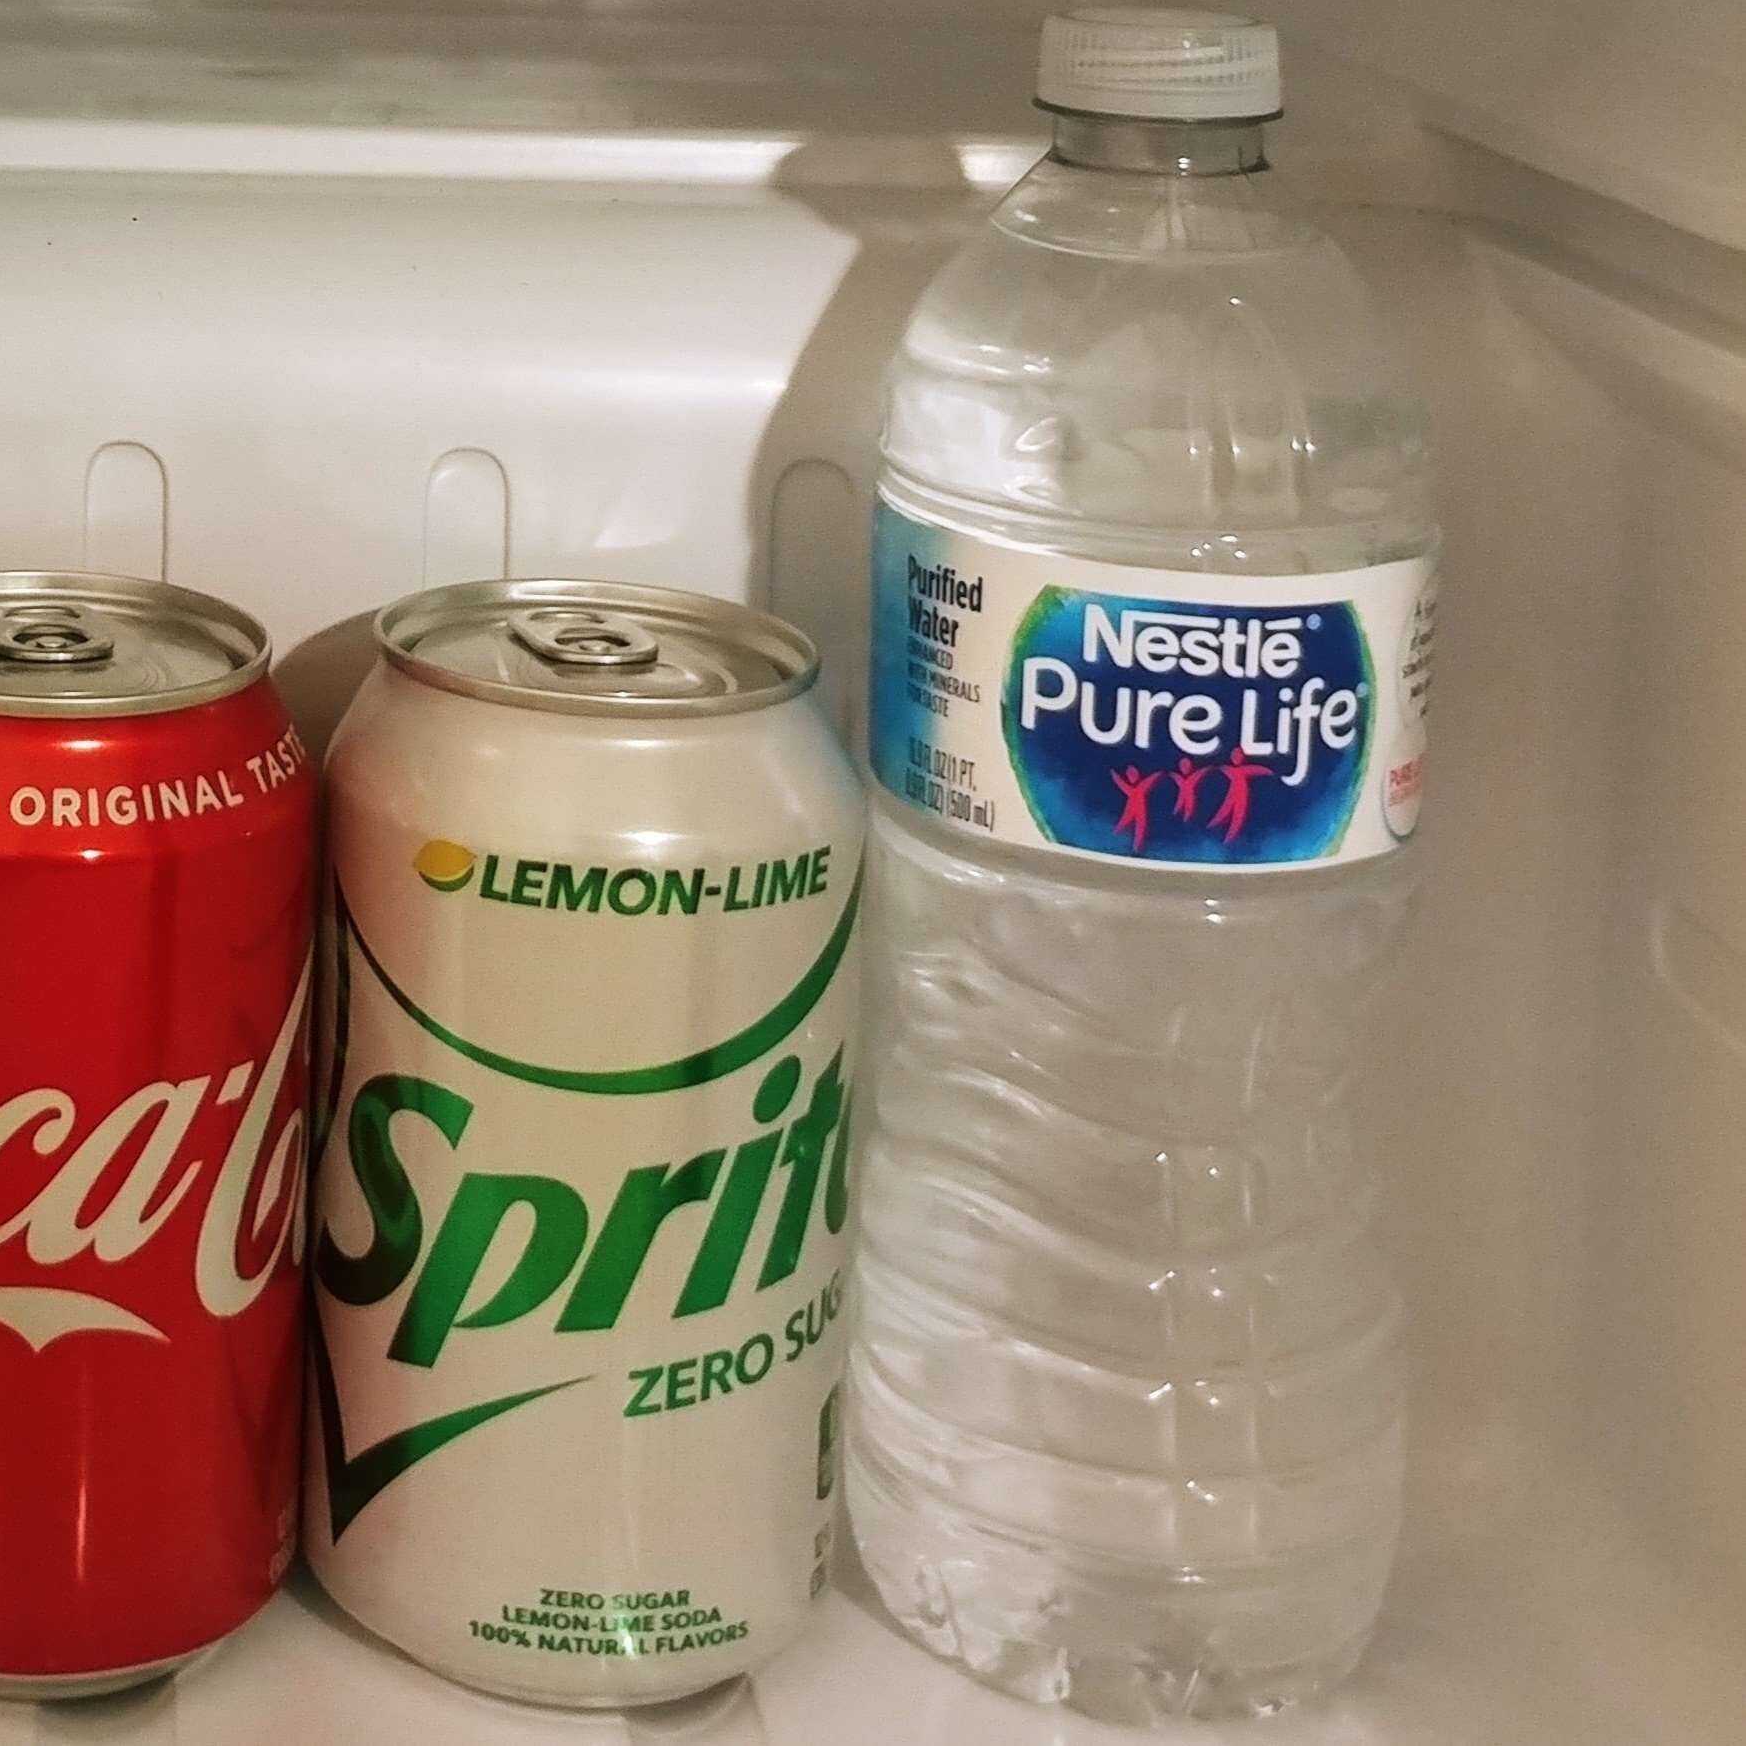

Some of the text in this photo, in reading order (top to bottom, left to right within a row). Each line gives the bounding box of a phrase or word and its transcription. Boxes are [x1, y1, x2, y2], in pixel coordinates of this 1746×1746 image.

[908, 554, 983, 612] Purified
[909, 598, 959, 647] Water
[1021, 656, 1220, 756] Pure
[1241, 678, 1357, 786] Life
[10, 770, 244, 829] ORIGINAL
[480, 848, 832, 915] LEMON-LIME
[624, 1334, 774, 1418] ZERO
[502, 1605, 722, 1633] LEMON-LIME SODA
[540, 1588, 690, 1610] ZERO SUGAR
[469, 1620, 531, 1648] 100%
[656, 1621, 748, 1653] FLAVORS
